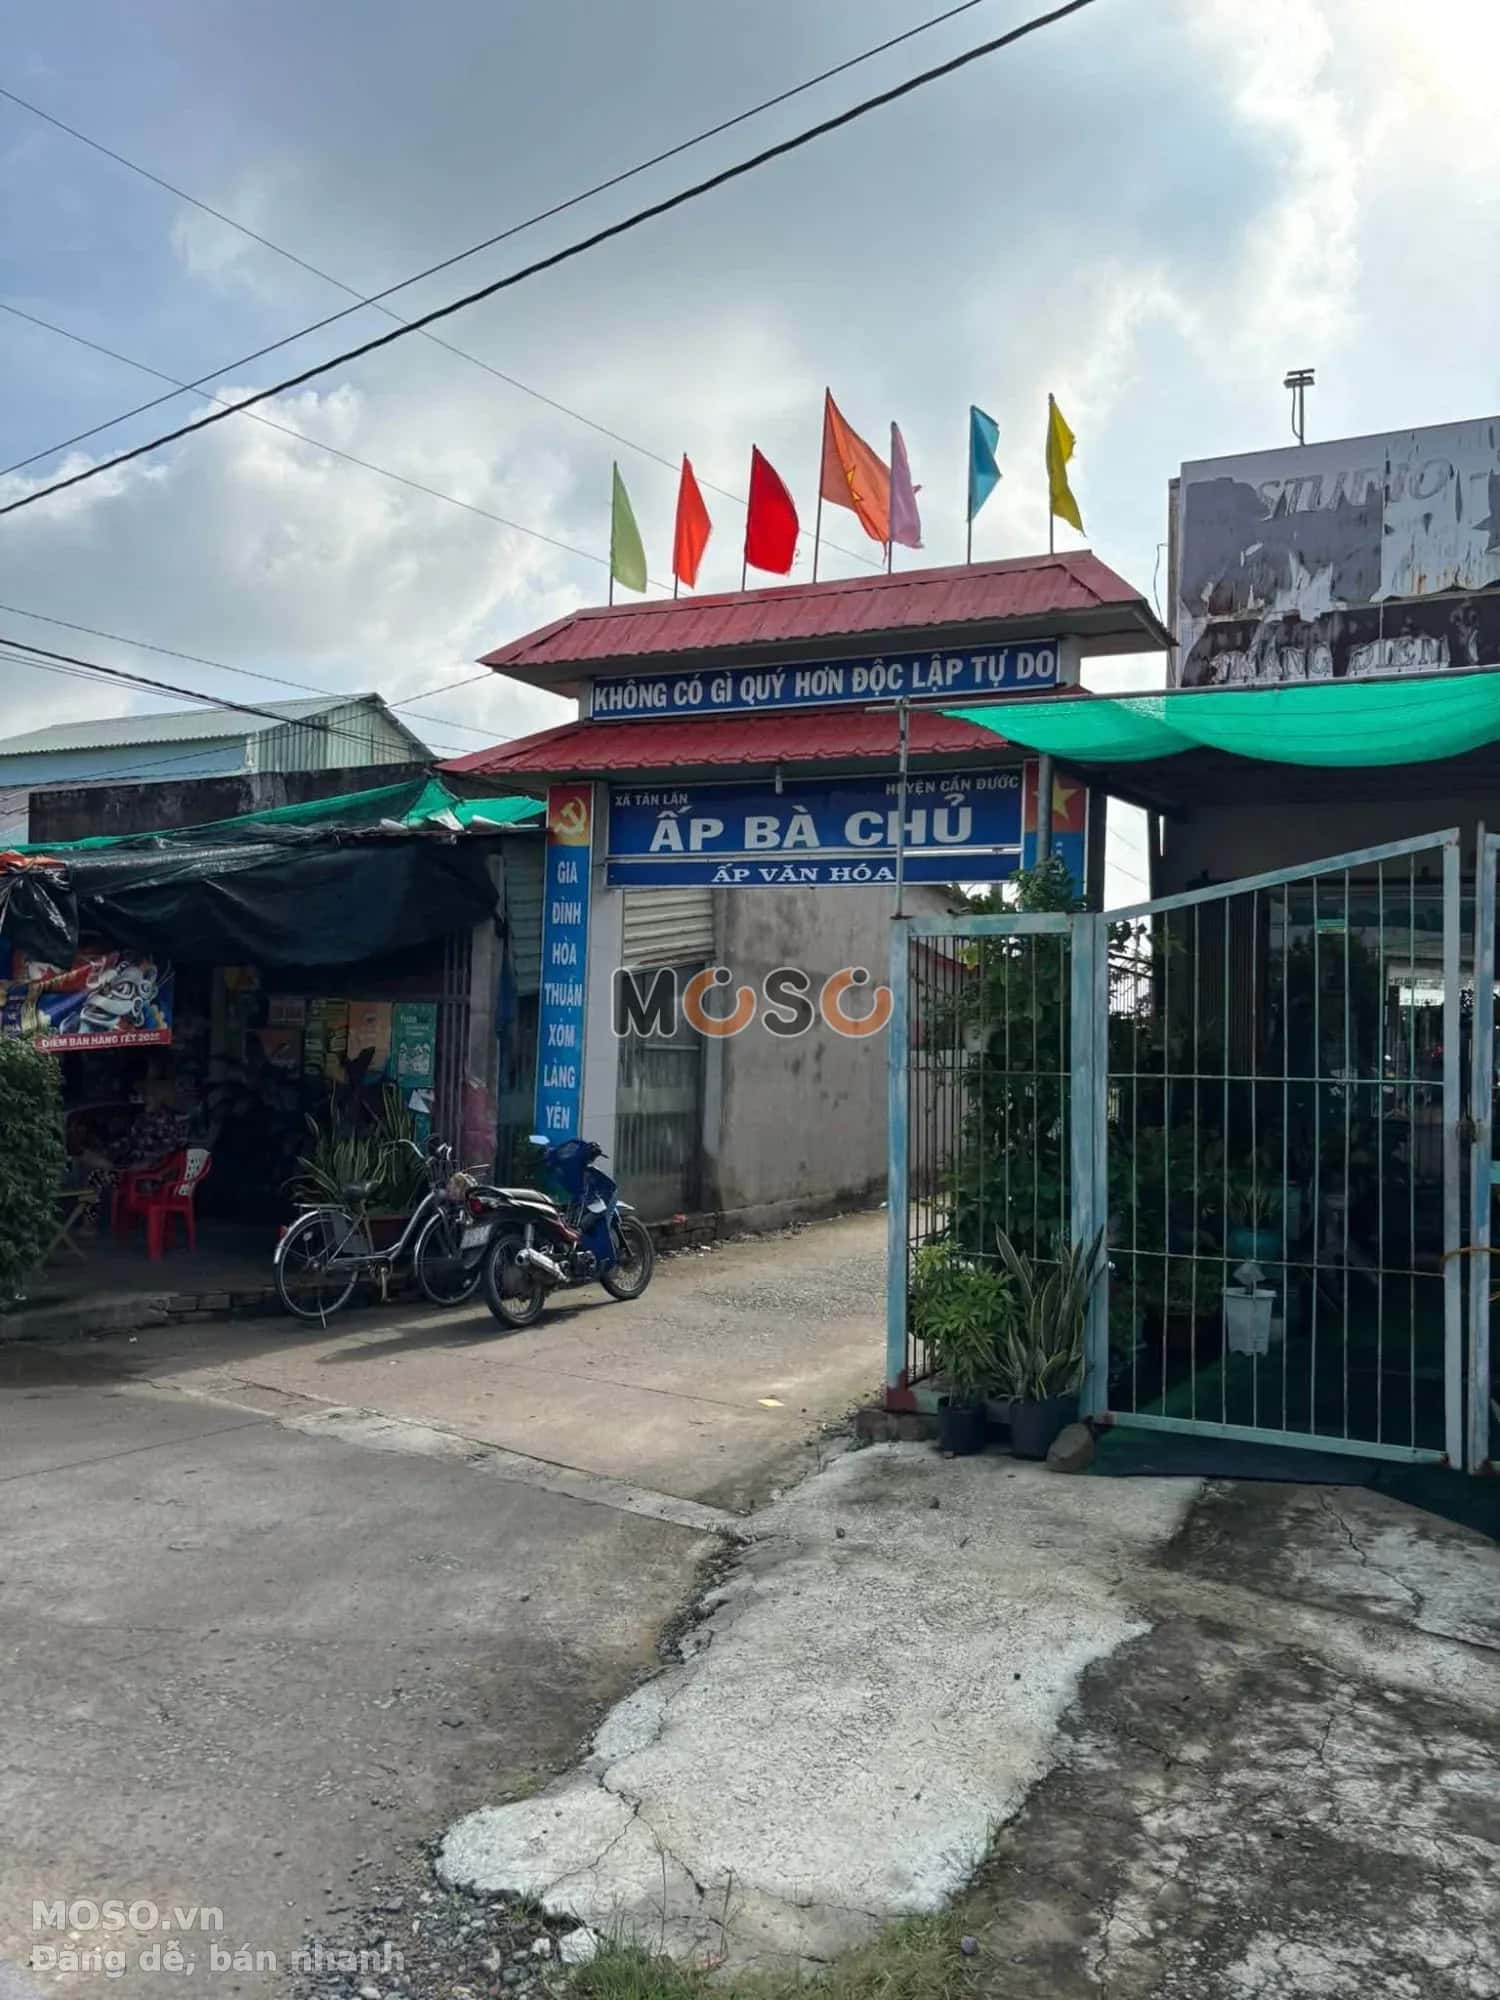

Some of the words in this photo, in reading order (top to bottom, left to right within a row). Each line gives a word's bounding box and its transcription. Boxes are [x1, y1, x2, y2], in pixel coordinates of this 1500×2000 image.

[594, 679, 667, 711] KHÔNG
[673, 673, 703, 705] CÓ
[711, 672, 733, 704] GÌ
[740, 667, 786, 706] QUÝ
[794, 666, 843, 698] HƠN
[852, 657, 904, 696] ĐỘC
[912, 653, 964, 692] LẬP
[970, 649, 1009, 687] TỰ
[1016, 650, 1055, 680] DO
[615, 795, 631, 807] XÃ
[636, 794, 660, 806] TÂN
[886, 780, 936, 796] HYỆN
[649, 805, 725, 852] ẤP
[744, 804, 820, 849] BÀ
[844, 793, 972, 846] CHỦ
[557, 860, 578, 884] GIA
[711, 863, 750, 883] ẤP
[758, 865, 818, 882] VĂN
[828, 863, 896, 881] HÓA
[552, 896, 582, 925] ĐÌNH
[552, 937, 577, 966] HÒA
[544, 976, 583, 1013] THUẬN
[548, 1018, 576, 1047] XÓM
[544, 1060, 576, 1088] LÀNG
[546, 1101, 570, 1129] YÊN
